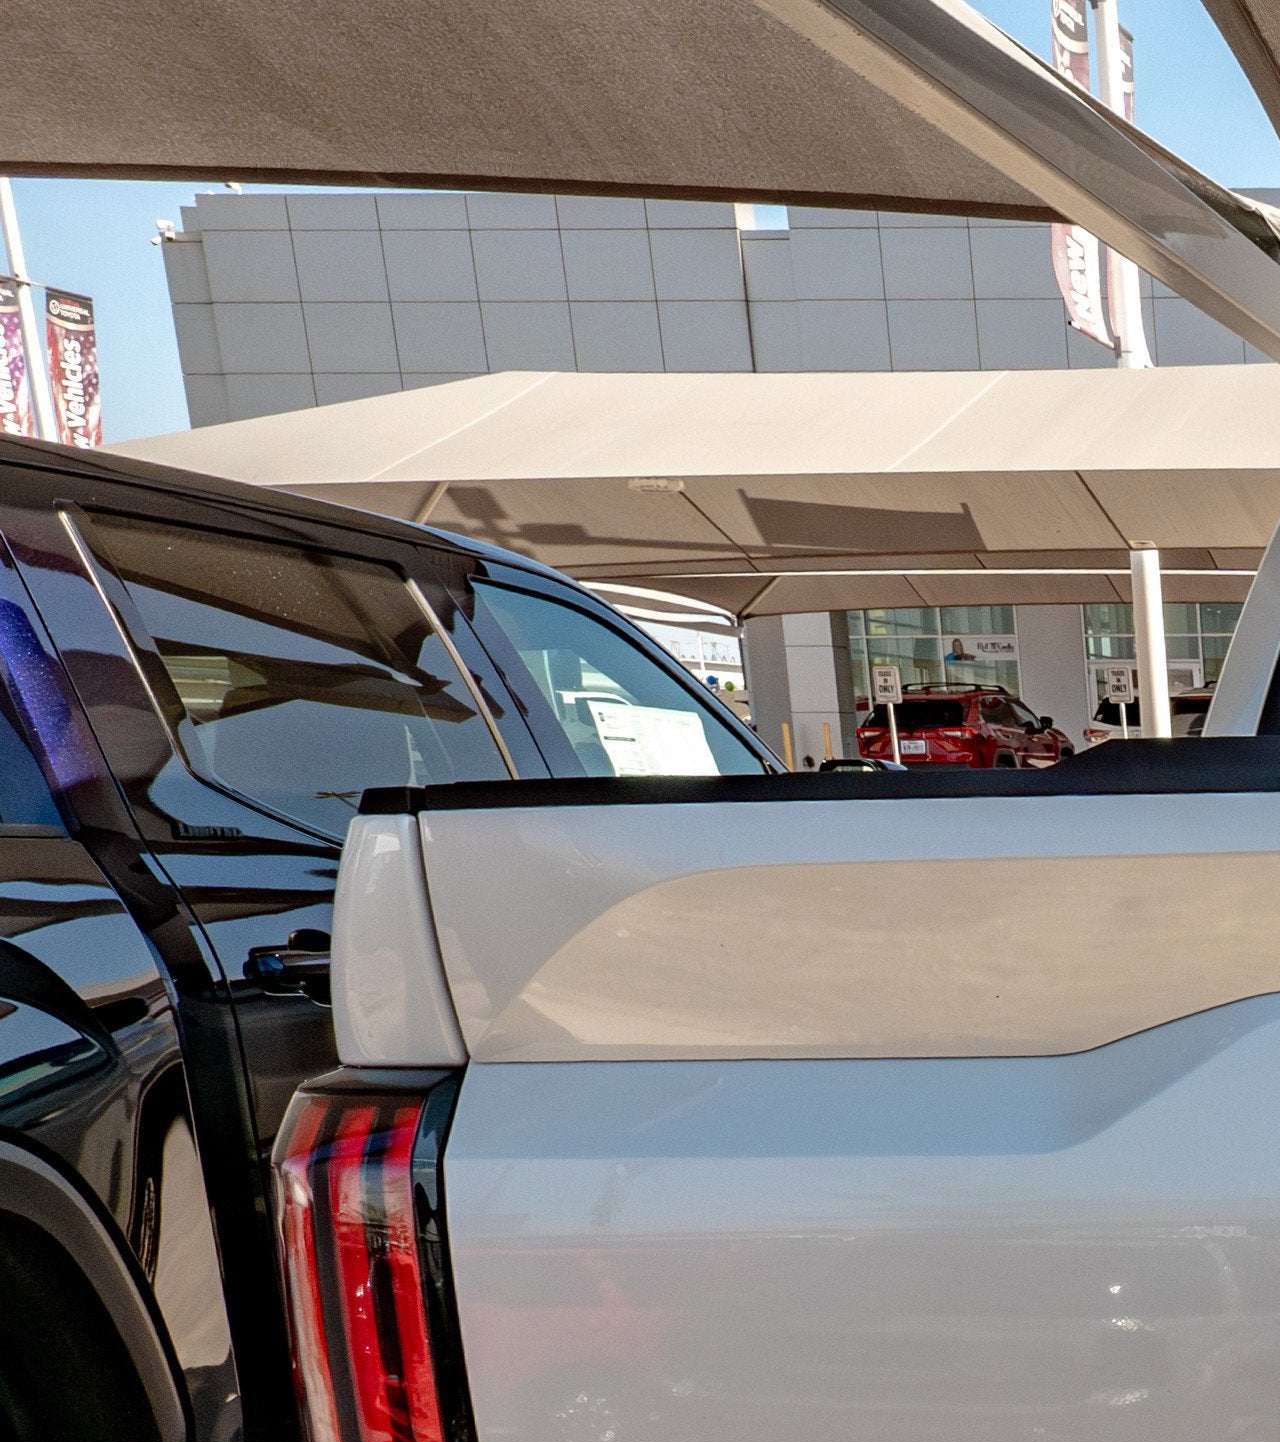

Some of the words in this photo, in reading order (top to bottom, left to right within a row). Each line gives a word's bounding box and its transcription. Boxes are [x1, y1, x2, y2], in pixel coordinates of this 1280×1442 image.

[61, 338, 87, 428] Vehicles
[879, 685, 894, 693] ONLY
[1112, 684, 1127, 693] ONLY
